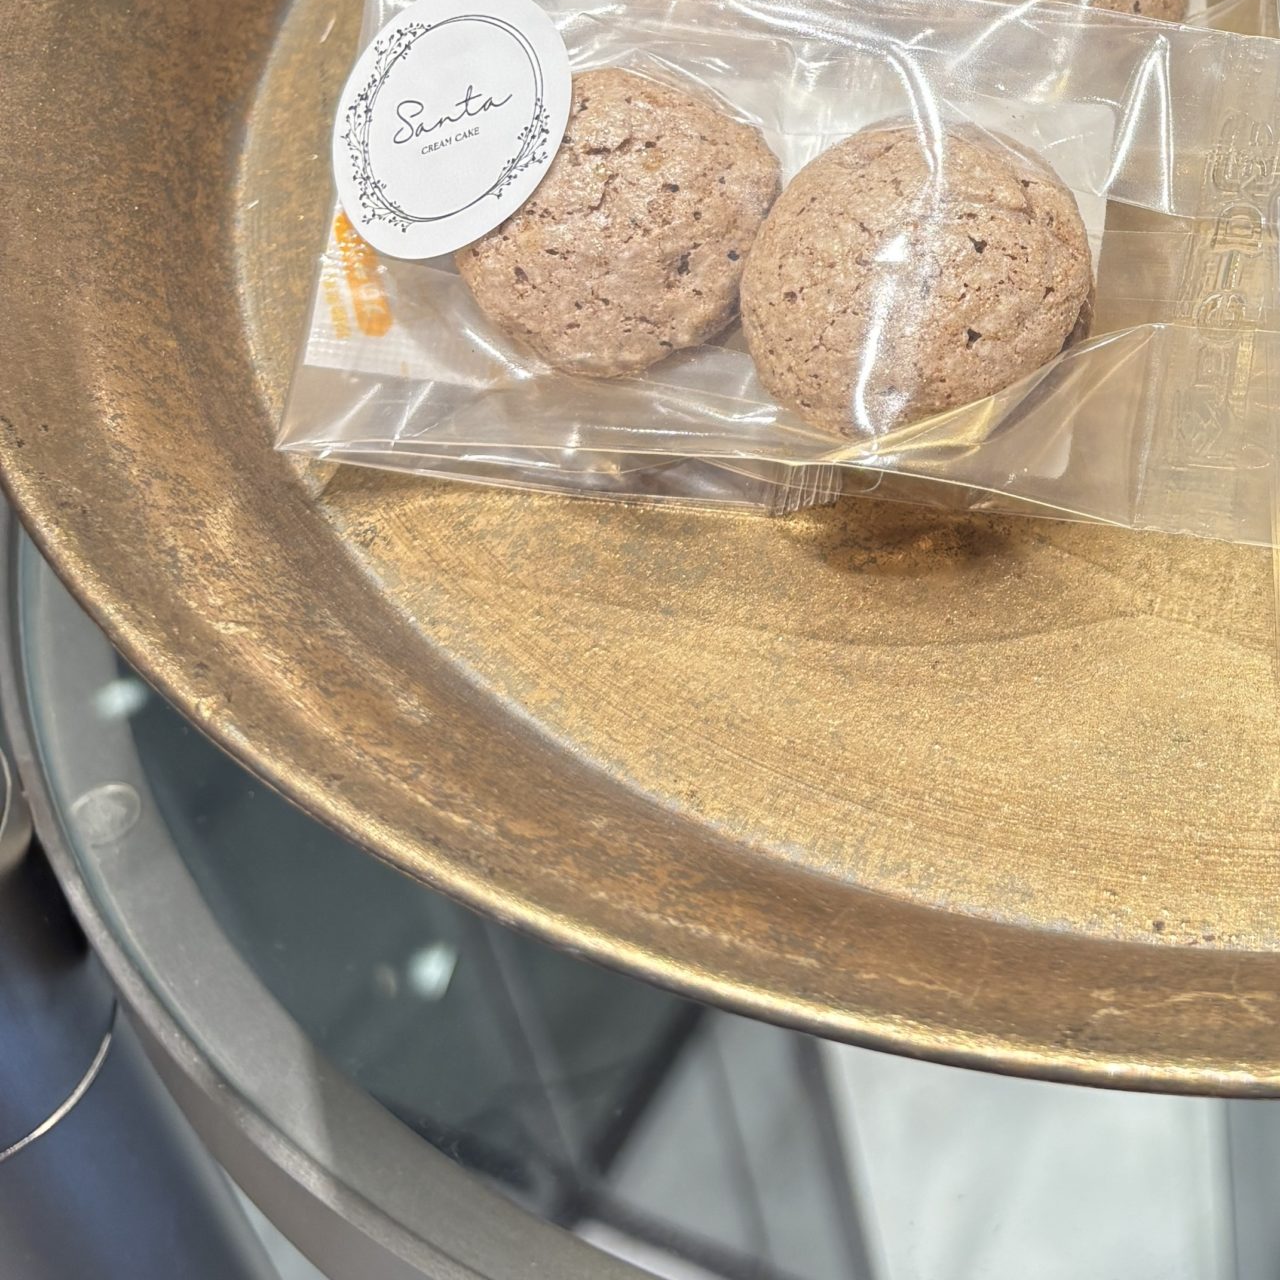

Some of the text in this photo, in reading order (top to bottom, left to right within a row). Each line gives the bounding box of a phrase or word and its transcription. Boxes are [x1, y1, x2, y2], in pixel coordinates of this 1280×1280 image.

[392, 84, 513, 145] Santa
[420, 126, 480, 155] CREAM CAKE
